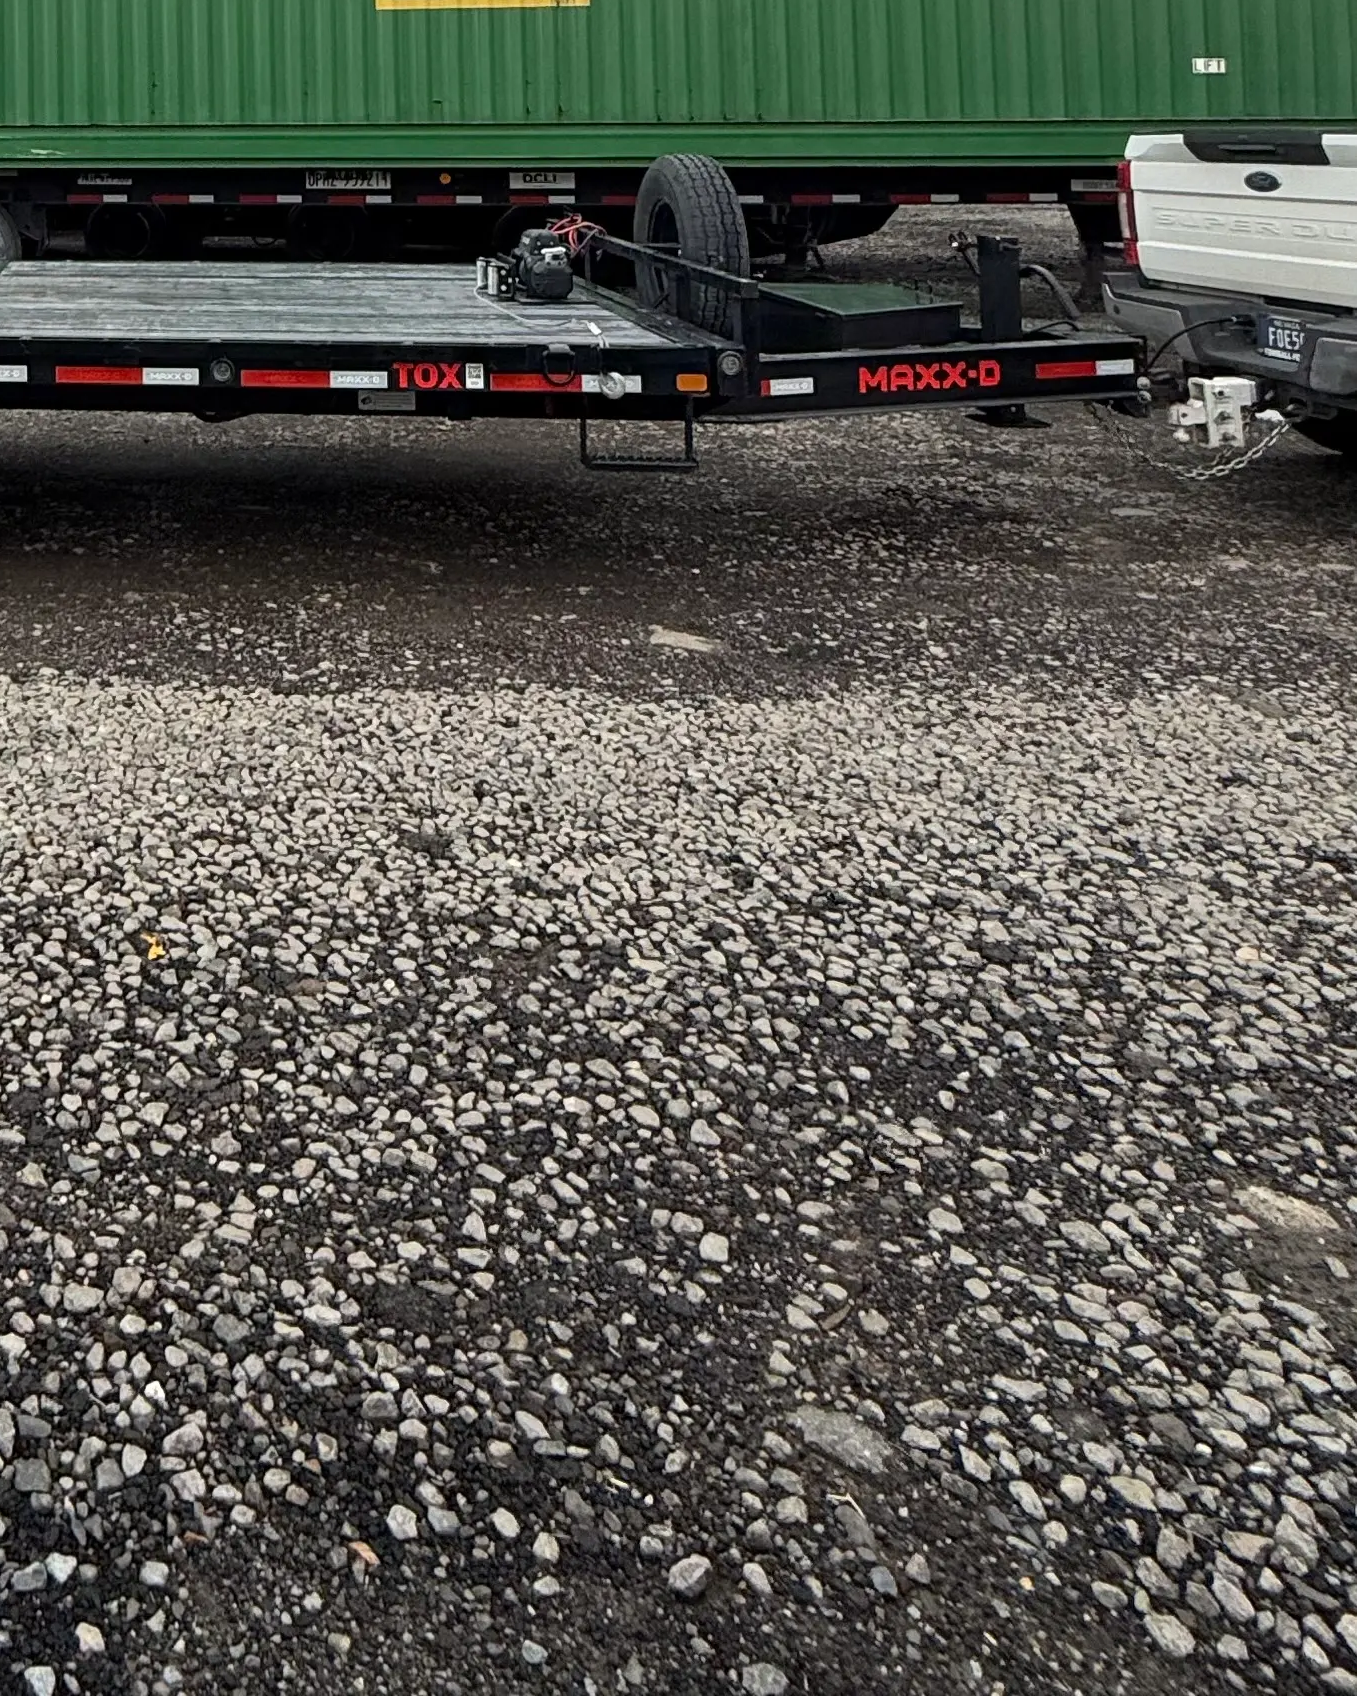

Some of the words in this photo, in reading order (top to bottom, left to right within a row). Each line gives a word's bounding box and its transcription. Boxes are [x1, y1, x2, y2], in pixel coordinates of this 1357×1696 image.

[1194, 59, 1224, 72] LIFT
[1155, 213, 1282, 237] SUPER
[149, 372, 192, 381] MAXX-D
[336, 375, 381, 384] MAXX-D
[393, 362, 463, 389] TOX
[859, 360, 1000, 393] MAXX-D
